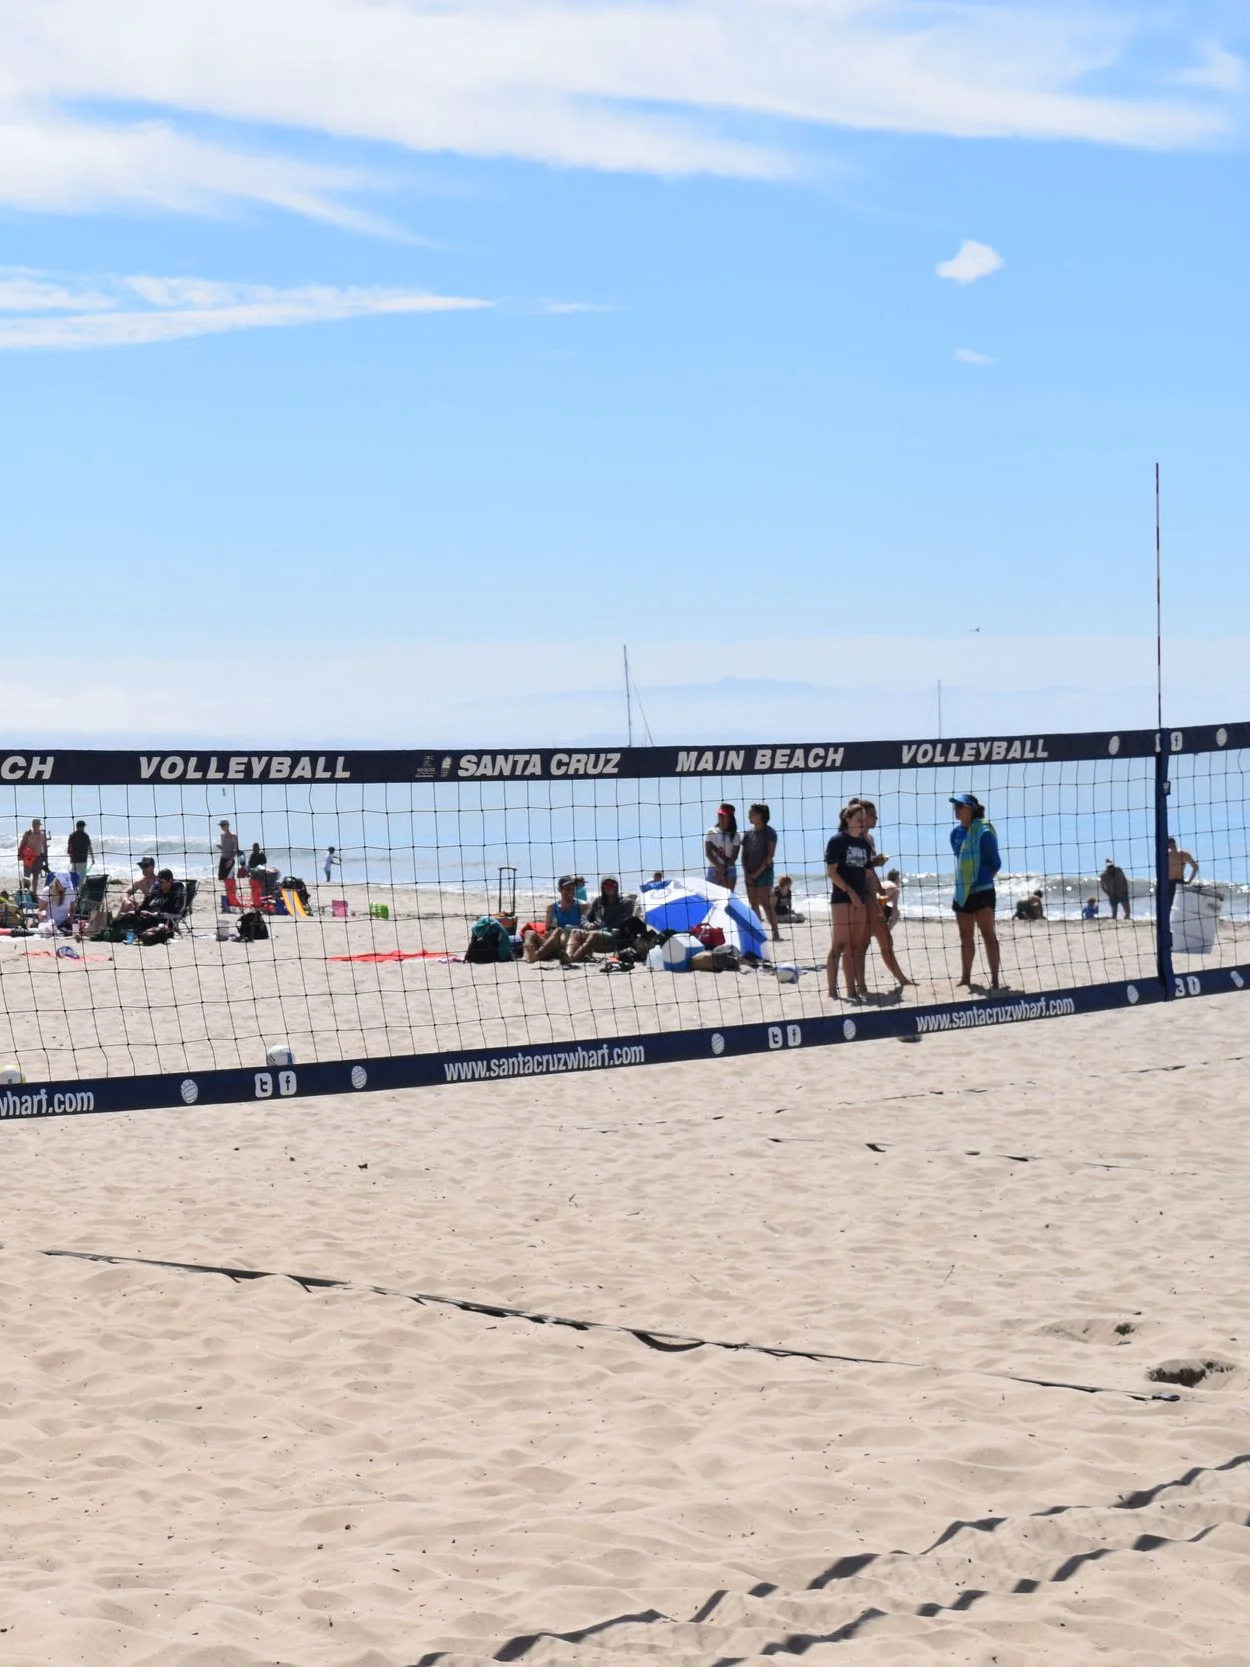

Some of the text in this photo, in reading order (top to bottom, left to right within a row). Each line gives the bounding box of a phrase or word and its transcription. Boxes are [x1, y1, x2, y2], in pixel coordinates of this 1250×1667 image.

[457, 754, 542, 777] SANTA
[550, 752, 621, 776] CRUZ
[675, 746, 845, 773] MAIN BEACH
[901, 738, 1049, 765] VOLLEYBALL
[139, 755, 351, 780] VOLLEYBALL
[915, 996, 1075, 1033] www.santacruzwharf.com
[443, 1043, 645, 1082] www.santacruzwharf.com
